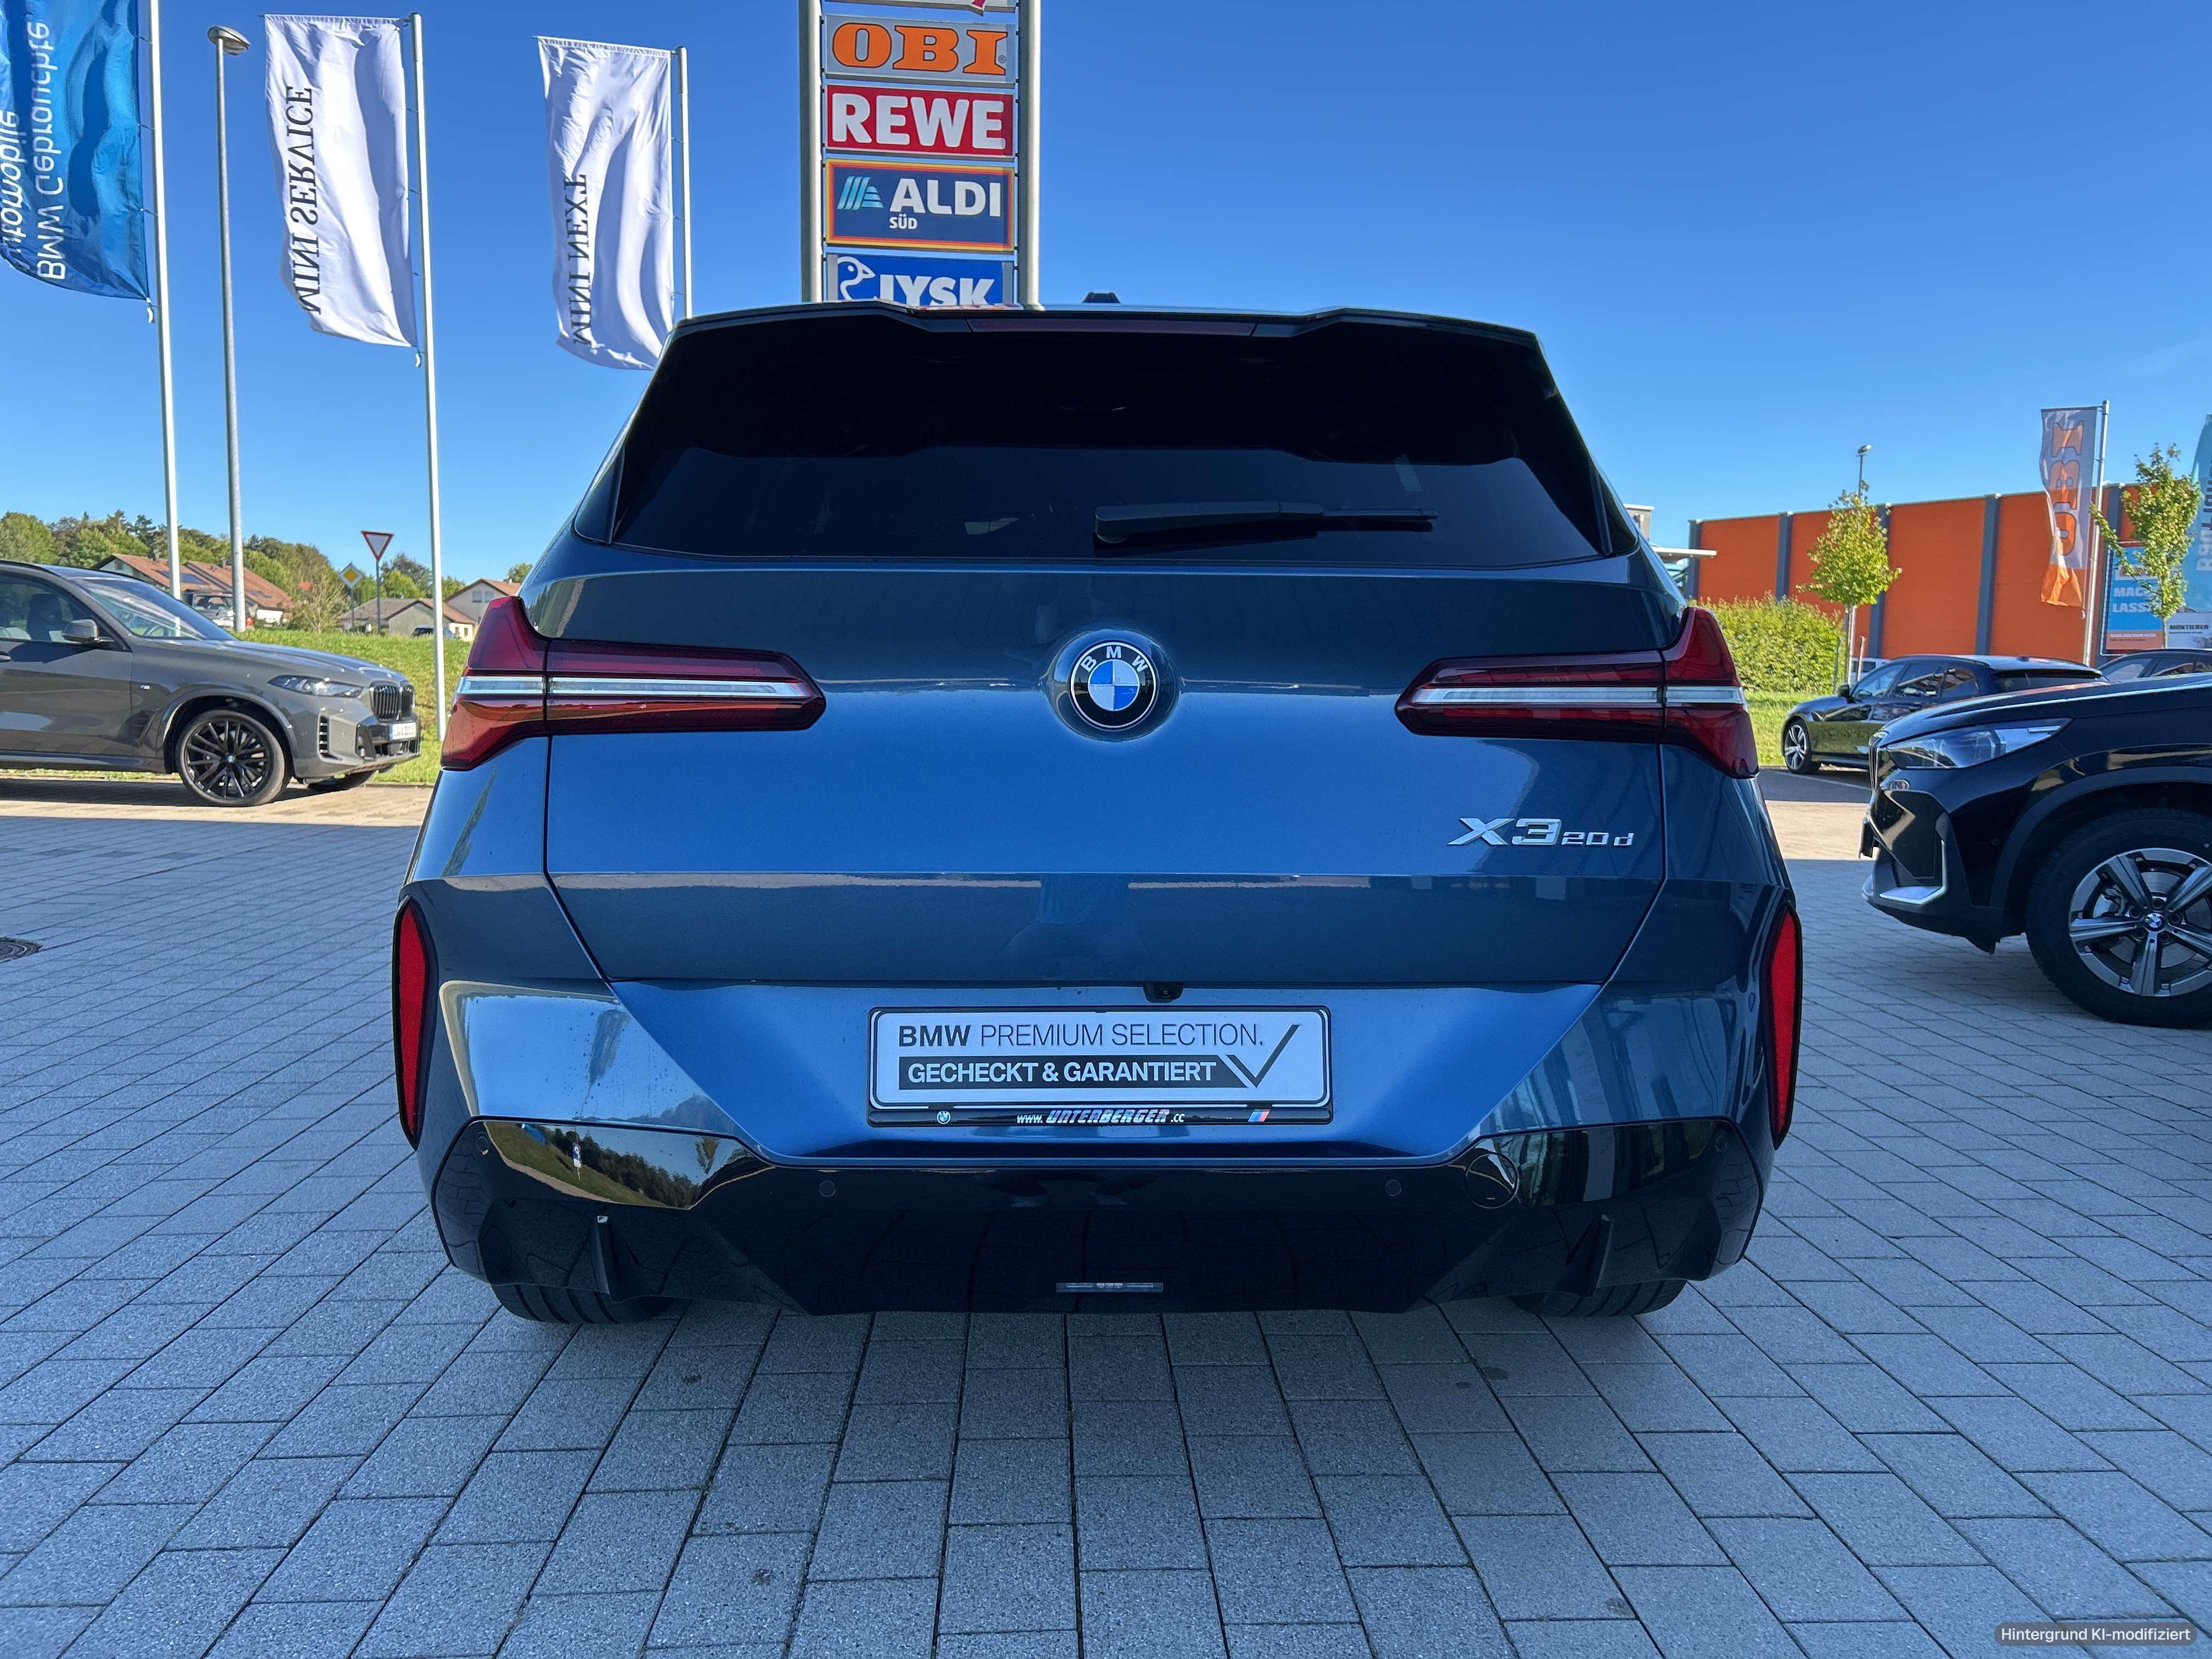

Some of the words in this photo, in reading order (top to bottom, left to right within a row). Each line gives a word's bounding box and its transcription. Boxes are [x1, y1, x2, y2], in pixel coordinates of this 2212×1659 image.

[832, 22, 1008, 76] OBI
[832, 93, 1006, 150] REWE
[889, 178, 1001, 217] ALDI
[889, 214, 918, 229] SÜD
[874, 274, 995, 307] JYSK
[1080, 646, 1148, 672] BMW
[1446, 817, 1561, 846] X3
[899, 1025, 971, 1047] BMW
[980, 1024, 1103, 1046] PREMIUM
[1111, 1023, 1264, 1046] SELECTION.
[907, 1062, 1039, 1084] GECHECKT
[1042, 1062, 1059, 1083] &
[1063, 1061, 1216, 1083] GARANTIERT
